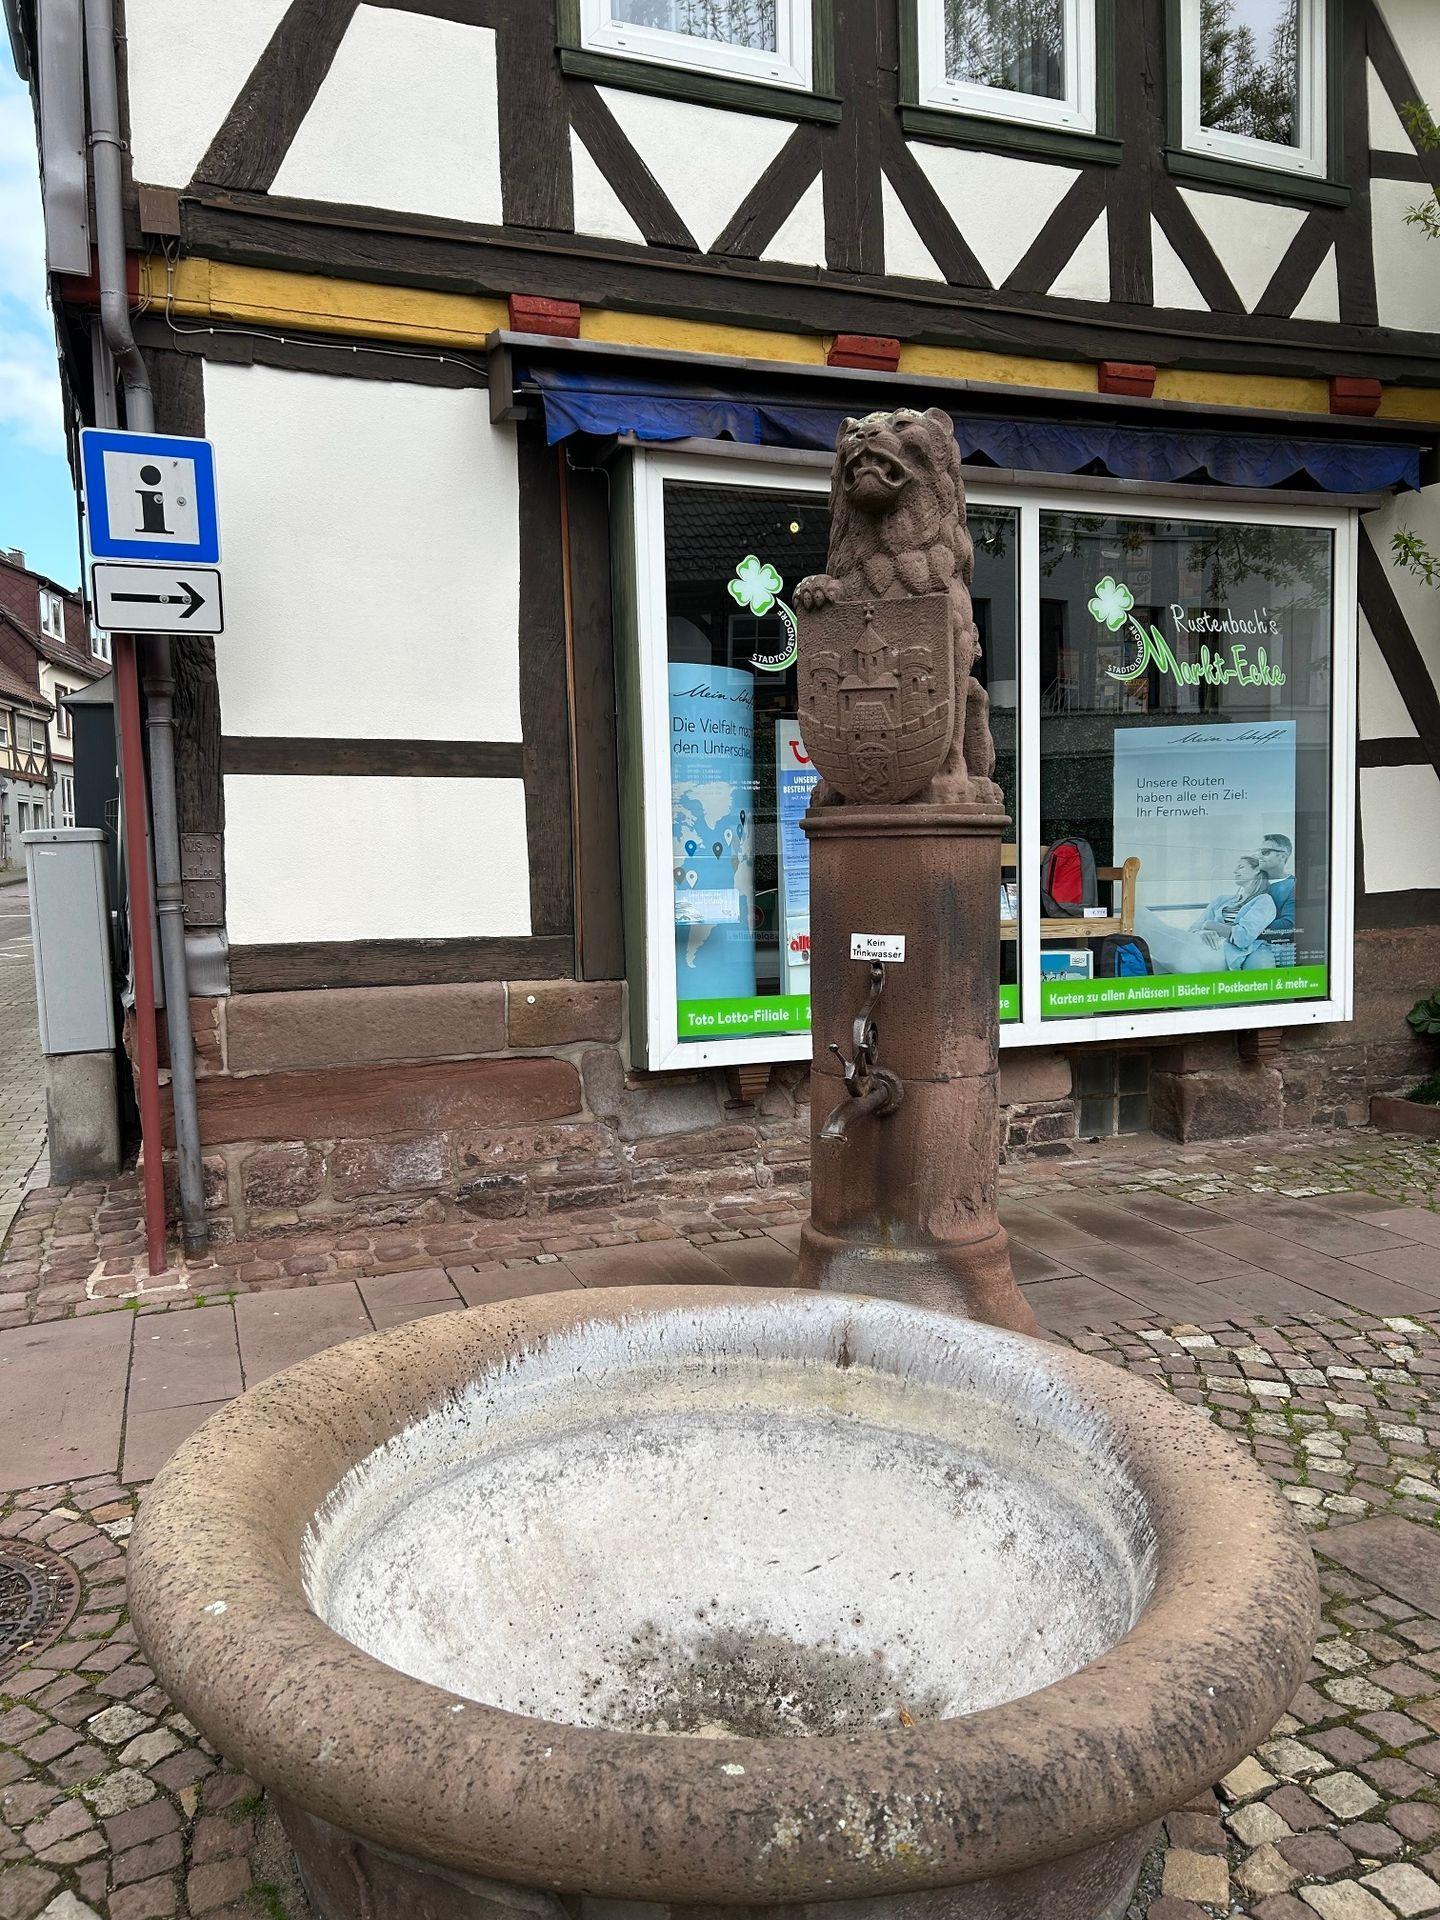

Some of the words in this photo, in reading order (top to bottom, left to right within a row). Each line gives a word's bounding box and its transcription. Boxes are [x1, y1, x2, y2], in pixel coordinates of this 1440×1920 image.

[1169, 603, 1279, 635] Rustenbach's
[752, 610, 795, 664] STADTOLDENDORF
[1107, 625, 1144, 674] STADTOLDENDORF
[1143, 624, 1287, 687] Markt-Ecke
[673, 716, 696, 733] Die
[699, 717, 737, 736] Vielfalt
[1167, 731, 1222, 744] Mein
[673, 739, 699, 754] den
[793, 776, 818, 784] UNSERE
[1136, 778, 1178, 788] Unsere
[1182, 775, 1225, 787] Routen
[783, 785, 806, 794] BESTEN
[1136, 792, 1173, 803] haben
[1176, 791, 1197, 802] alle
[1201, 791, 1219, 801] ein
[1223, 789, 1248, 800] Ziel:
[1136, 806, 1152, 818] Ihr
[1156, 805, 1209, 817] Fernweh.
[866, 938, 886, 947] Kein
[852, 948, 902, 958] Trinkwasser
[1049, 993, 1085, 1006] Karten
[1086, 994, 1099, 1003] zu
[1101, 989, 1125, 1002] allen
[1127, 987, 1170, 1000] Anlässen
[1177, 984, 1211, 997] Bücher
[1218, 980, 1268, 994] Postkarten
[1275, 979, 1284, 990] &
[1285, 977, 1308, 989] mehr
[688, 1013, 715, 1026] Toto
[717, 1008, 790, 1025] Lotto-Filiale
